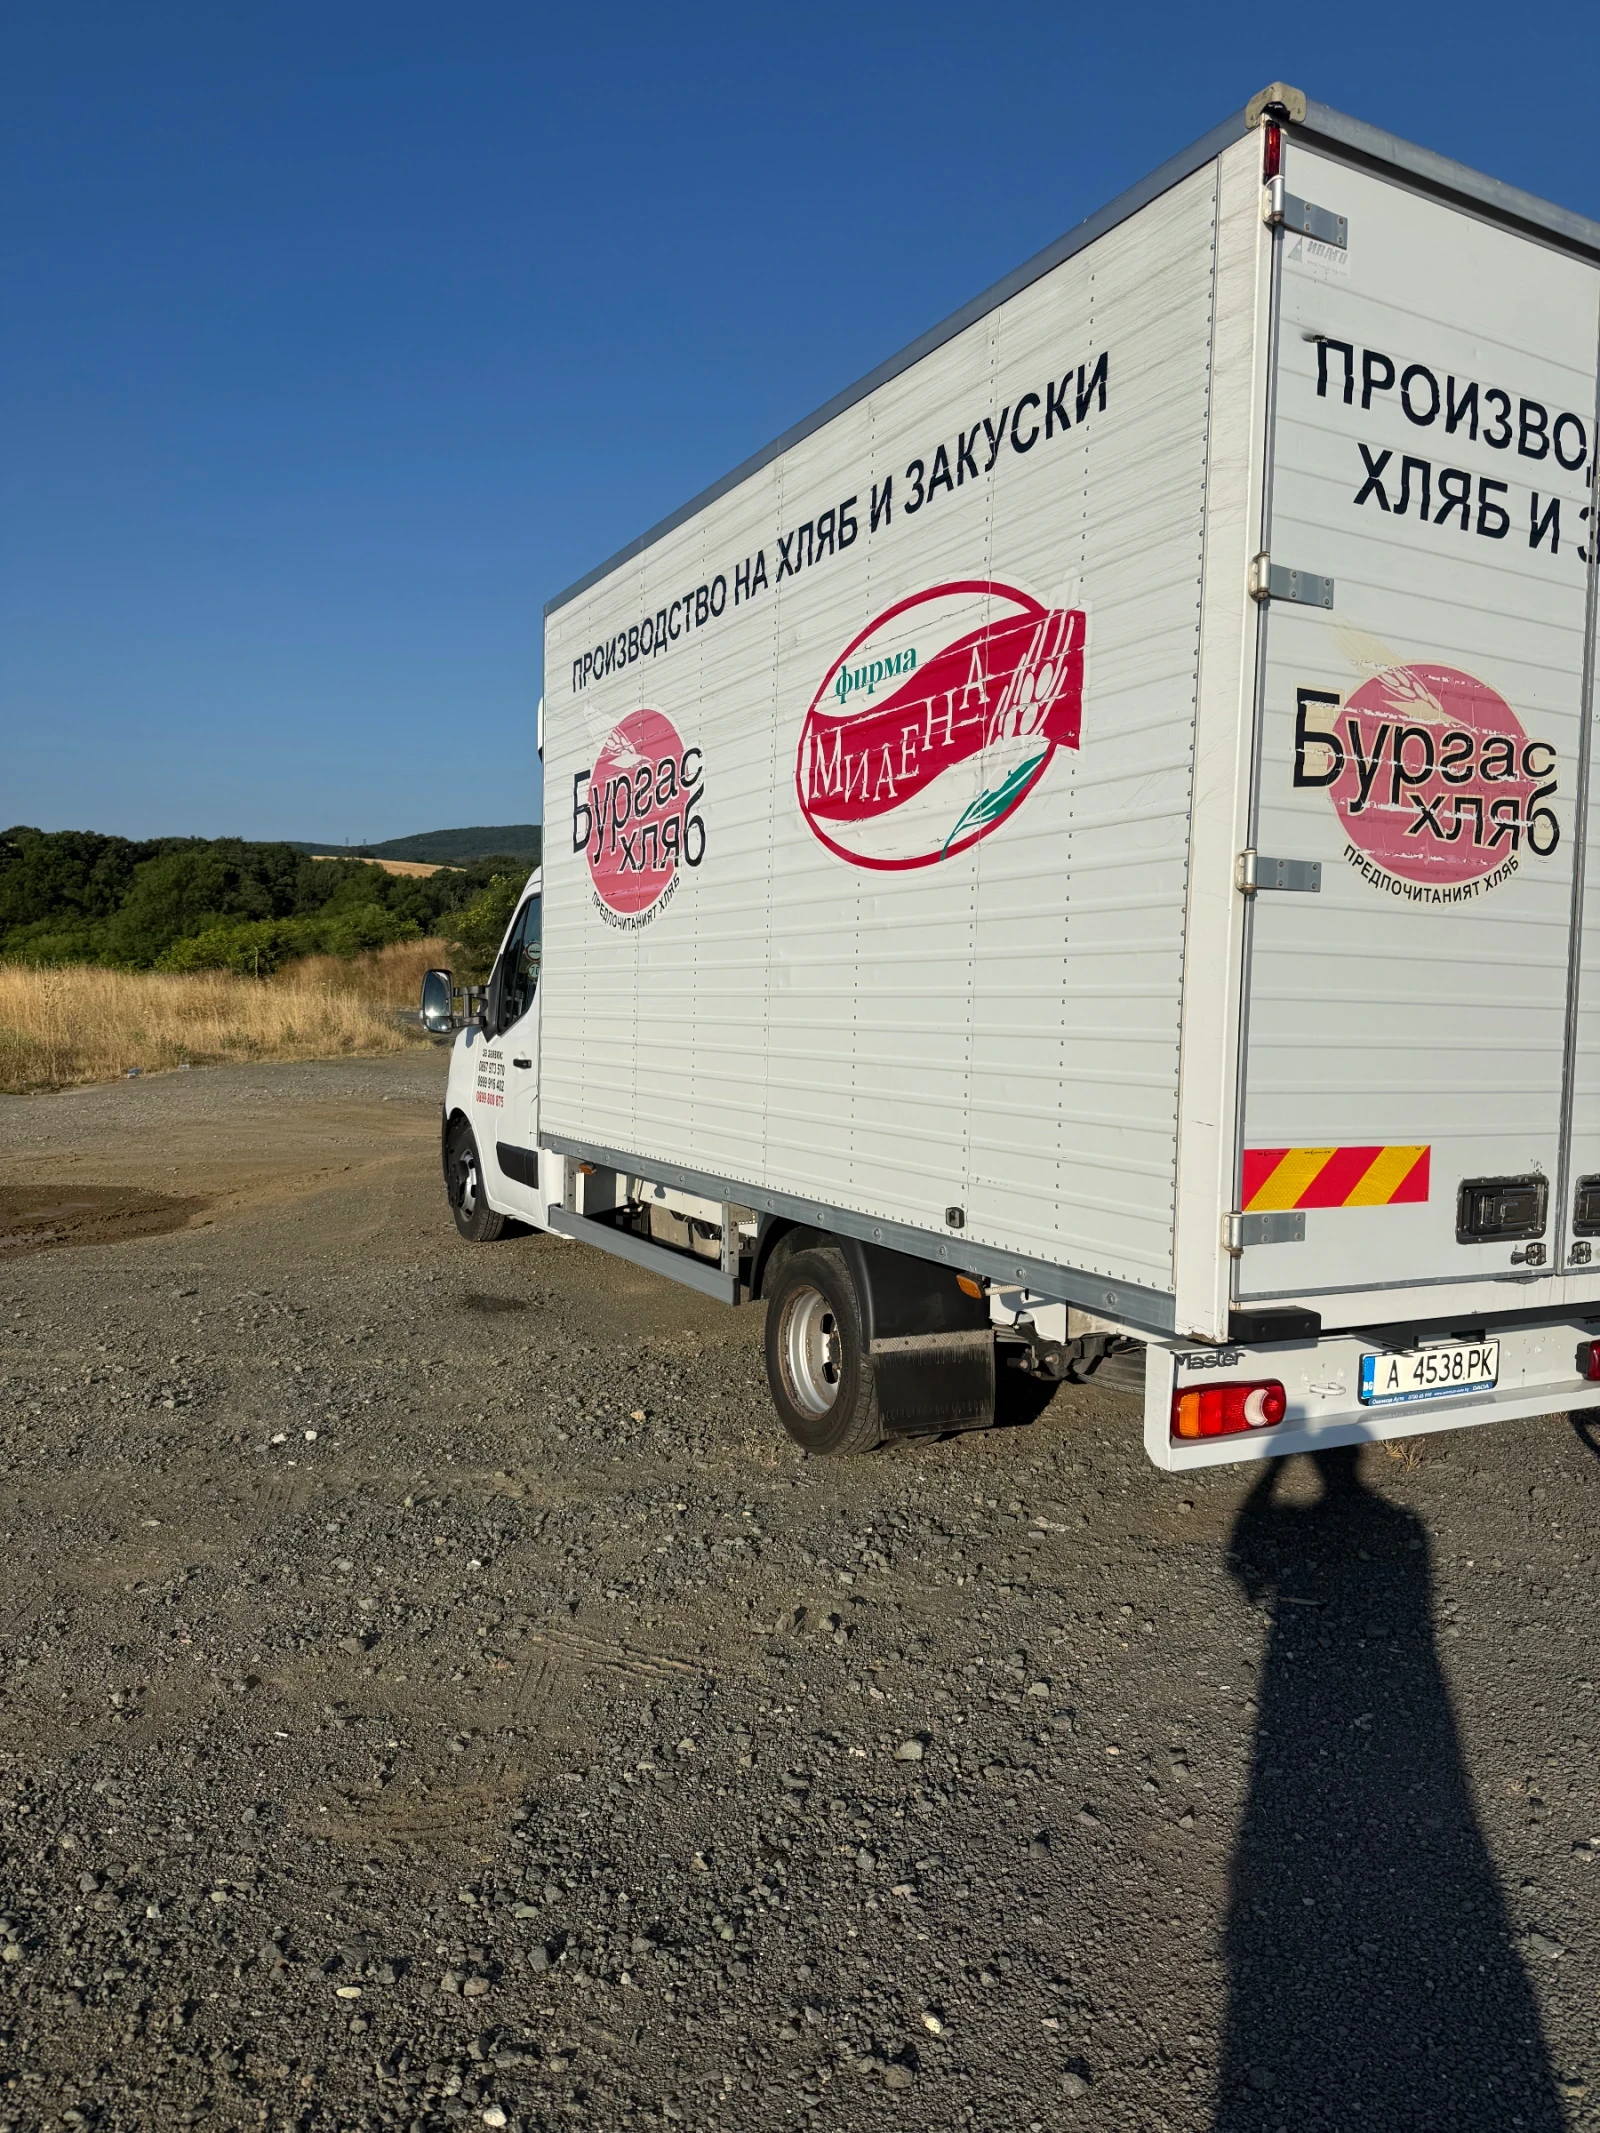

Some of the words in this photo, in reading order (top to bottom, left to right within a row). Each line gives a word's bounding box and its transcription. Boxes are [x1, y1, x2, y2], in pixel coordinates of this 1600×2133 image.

[572, 574, 727, 693] ПРОИЗВОДСТВО
[734, 550, 769, 606] НА
[775, 496, 858, 582] ХЛЯБ
[869, 475, 892, 533] И
[905, 351, 1109, 514] ЗАКУСКИ
[1353, 442, 1510, 539] ХЛЯБ
[1529, 491, 1561, 554] И
[835, 647, 917, 704] фирма
[1293, 687, 1557, 813] Бургас
[573, 747, 703, 864] Бургас
[619, 781, 706, 872] хляб
[1406, 781, 1560, 857] хляб
[591, 890, 657, 932] ПРЕДПОЧИТАНИЯТ
[658, 872, 680, 914] ХЛЯБ
[1343, 844, 1481, 904] ПРЕДПОЧИТАНИЯТ
[1484, 855, 1519, 892] ХЛЯБ
[1170, 1350, 1246, 1370] Master
[1363, 1381, 1374, 1392] BG
[1387, 1359, 1399, 1389] A
[1413, 1352, 1463, 1386] 4538
